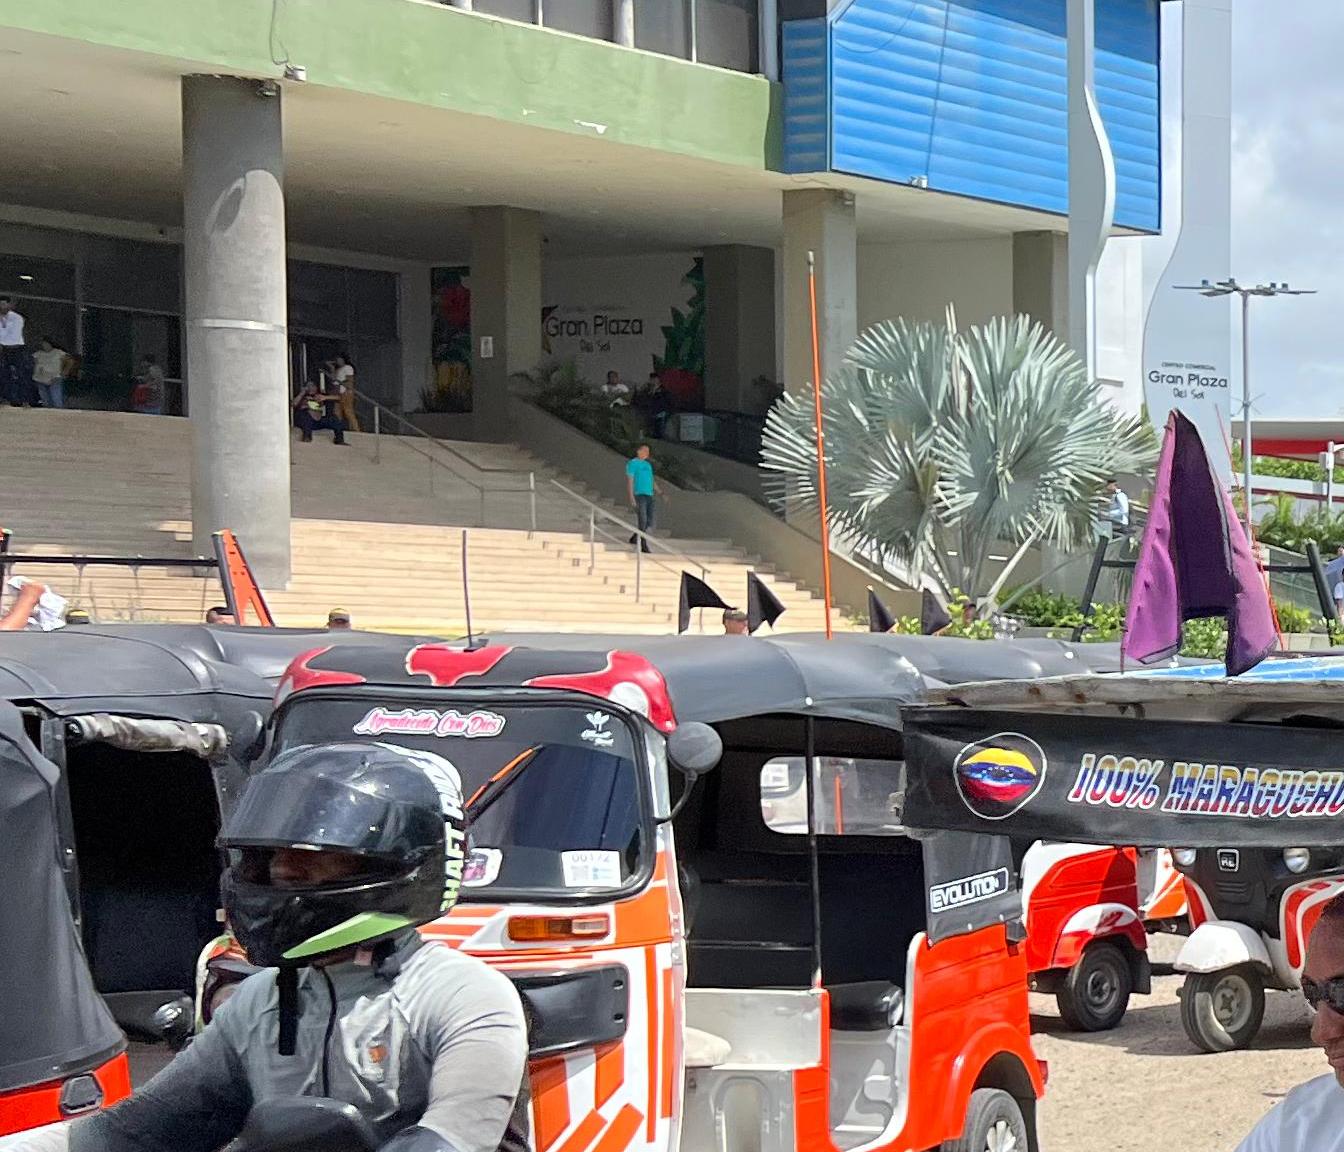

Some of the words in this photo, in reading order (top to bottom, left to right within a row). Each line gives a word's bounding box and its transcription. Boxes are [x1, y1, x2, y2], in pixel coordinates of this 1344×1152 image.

[546, 316, 588, 336] Gran
[594, 314, 643, 335] Plaza
[1148, 370, 1184, 385] Gran
[1187, 373, 1228, 388] Plaza
[1068, 754, 1164, 808] 100%
[931, 875, 1000, 908] EVOLUTION
